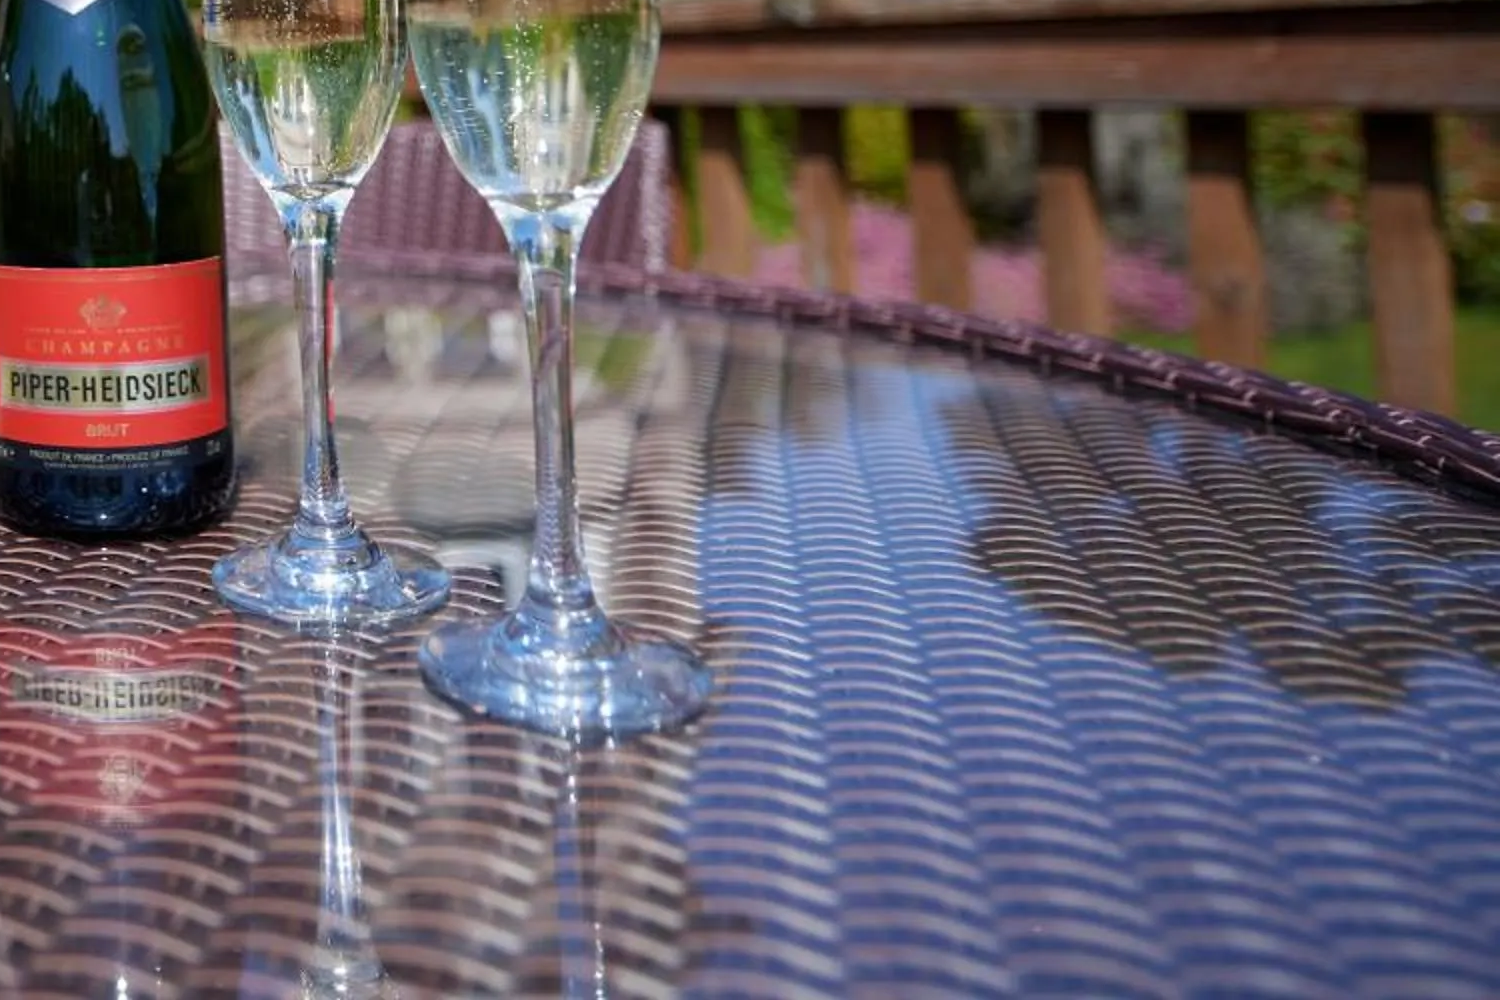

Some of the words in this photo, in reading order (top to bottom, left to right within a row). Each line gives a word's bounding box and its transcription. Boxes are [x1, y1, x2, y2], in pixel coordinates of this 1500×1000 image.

[25, 334, 186, 356] CHAMPAGNE
[10, 366, 202, 403] PIPER-HEIDSIECK
[85, 423, 130, 438] BRUT
